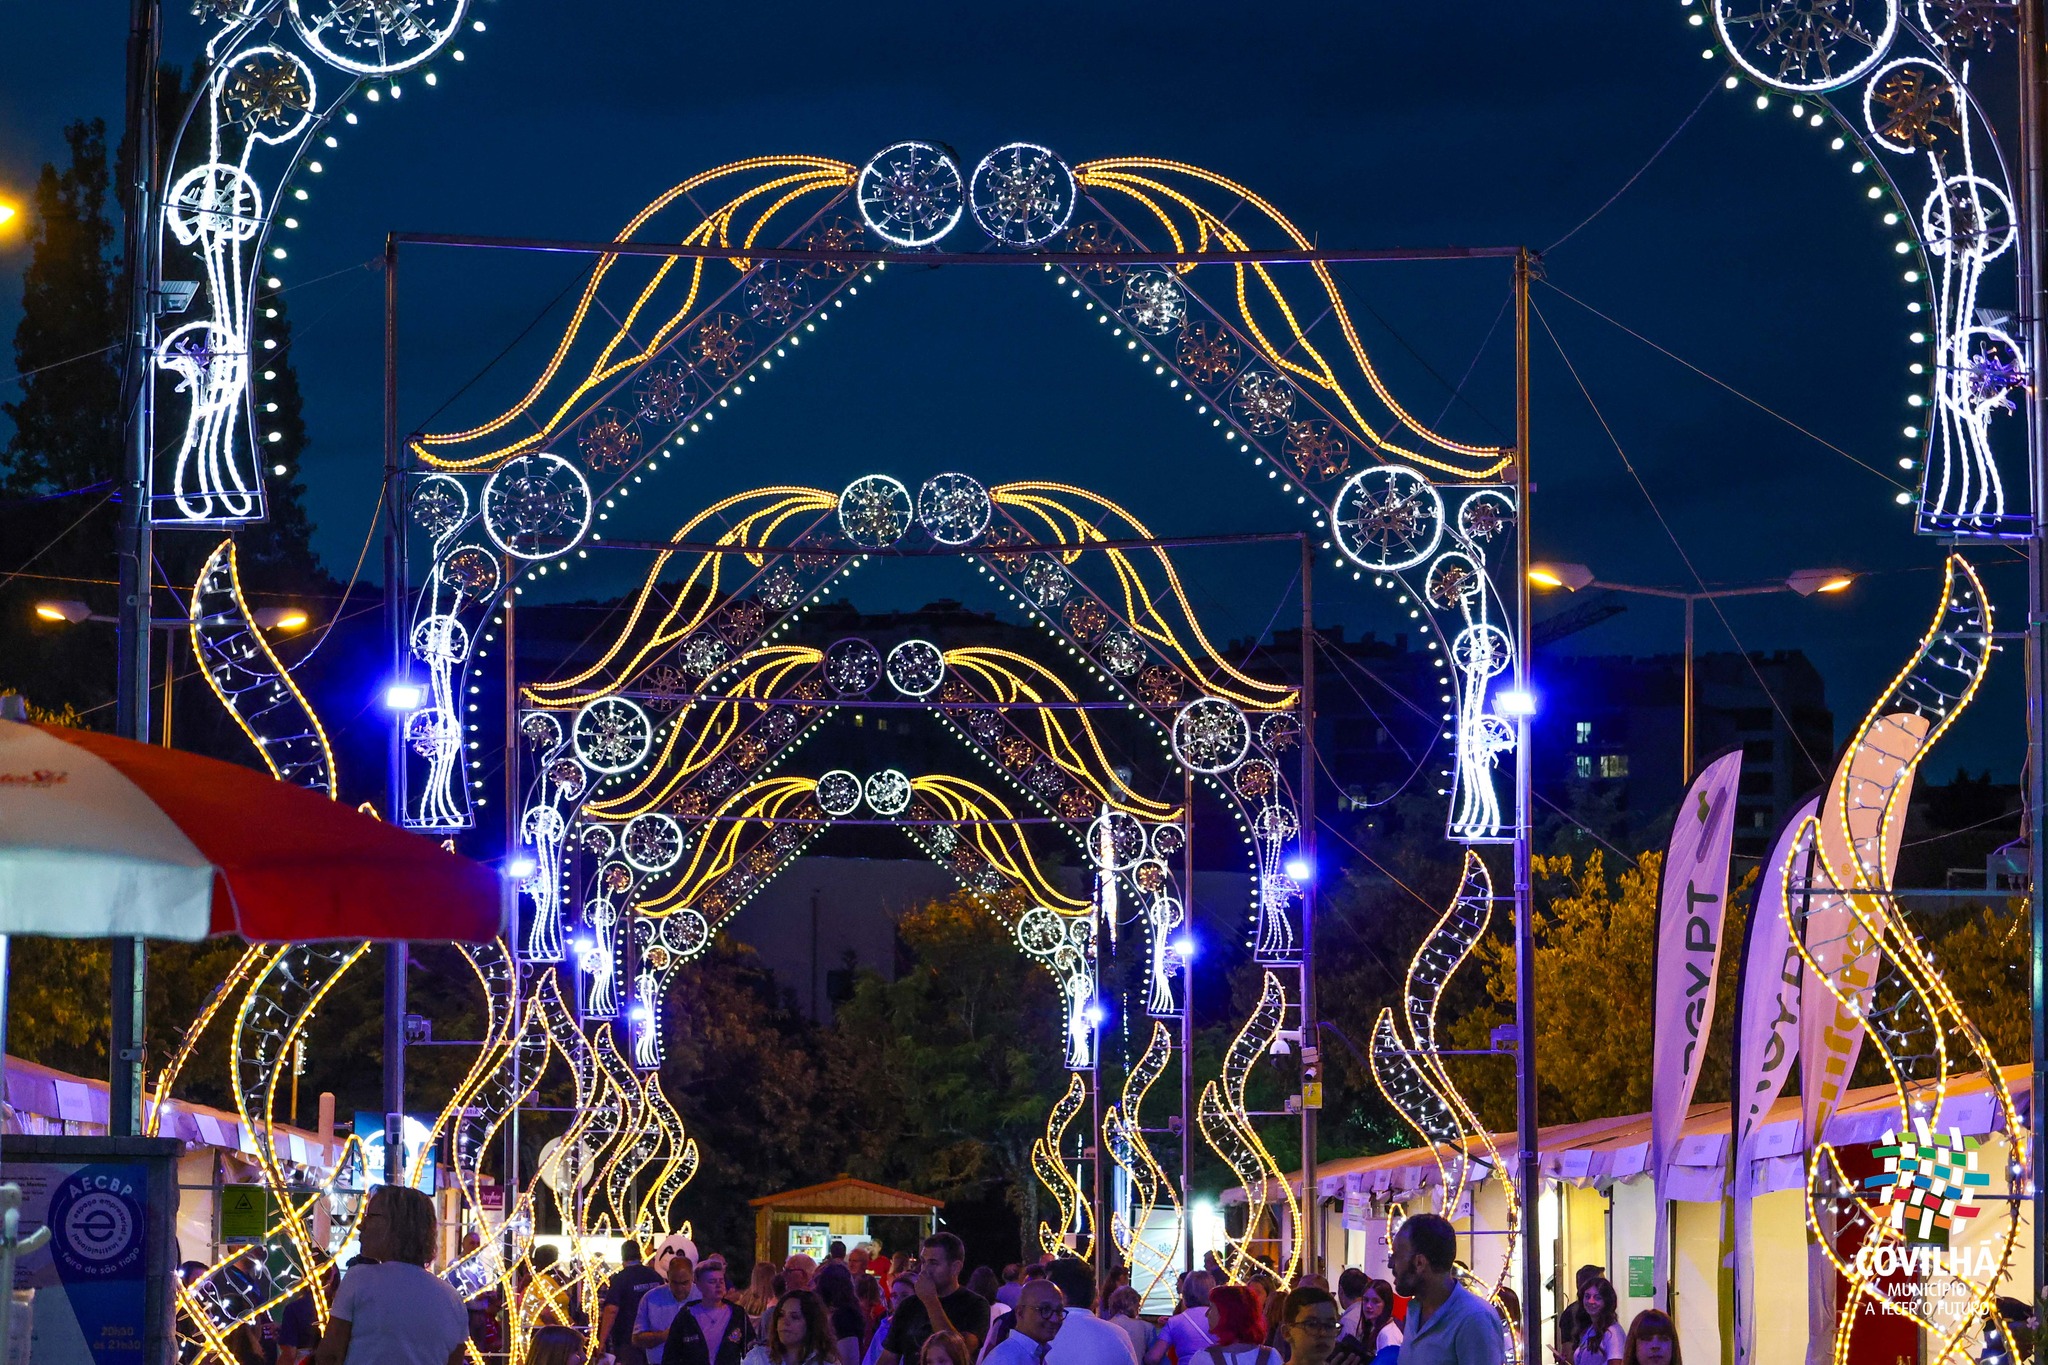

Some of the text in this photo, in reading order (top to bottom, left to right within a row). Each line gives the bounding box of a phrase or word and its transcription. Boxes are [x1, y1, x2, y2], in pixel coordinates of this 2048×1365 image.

[69, 1175, 133, 1199] AECBP
[62, 1247, 140, 1274] feira de são tiago
